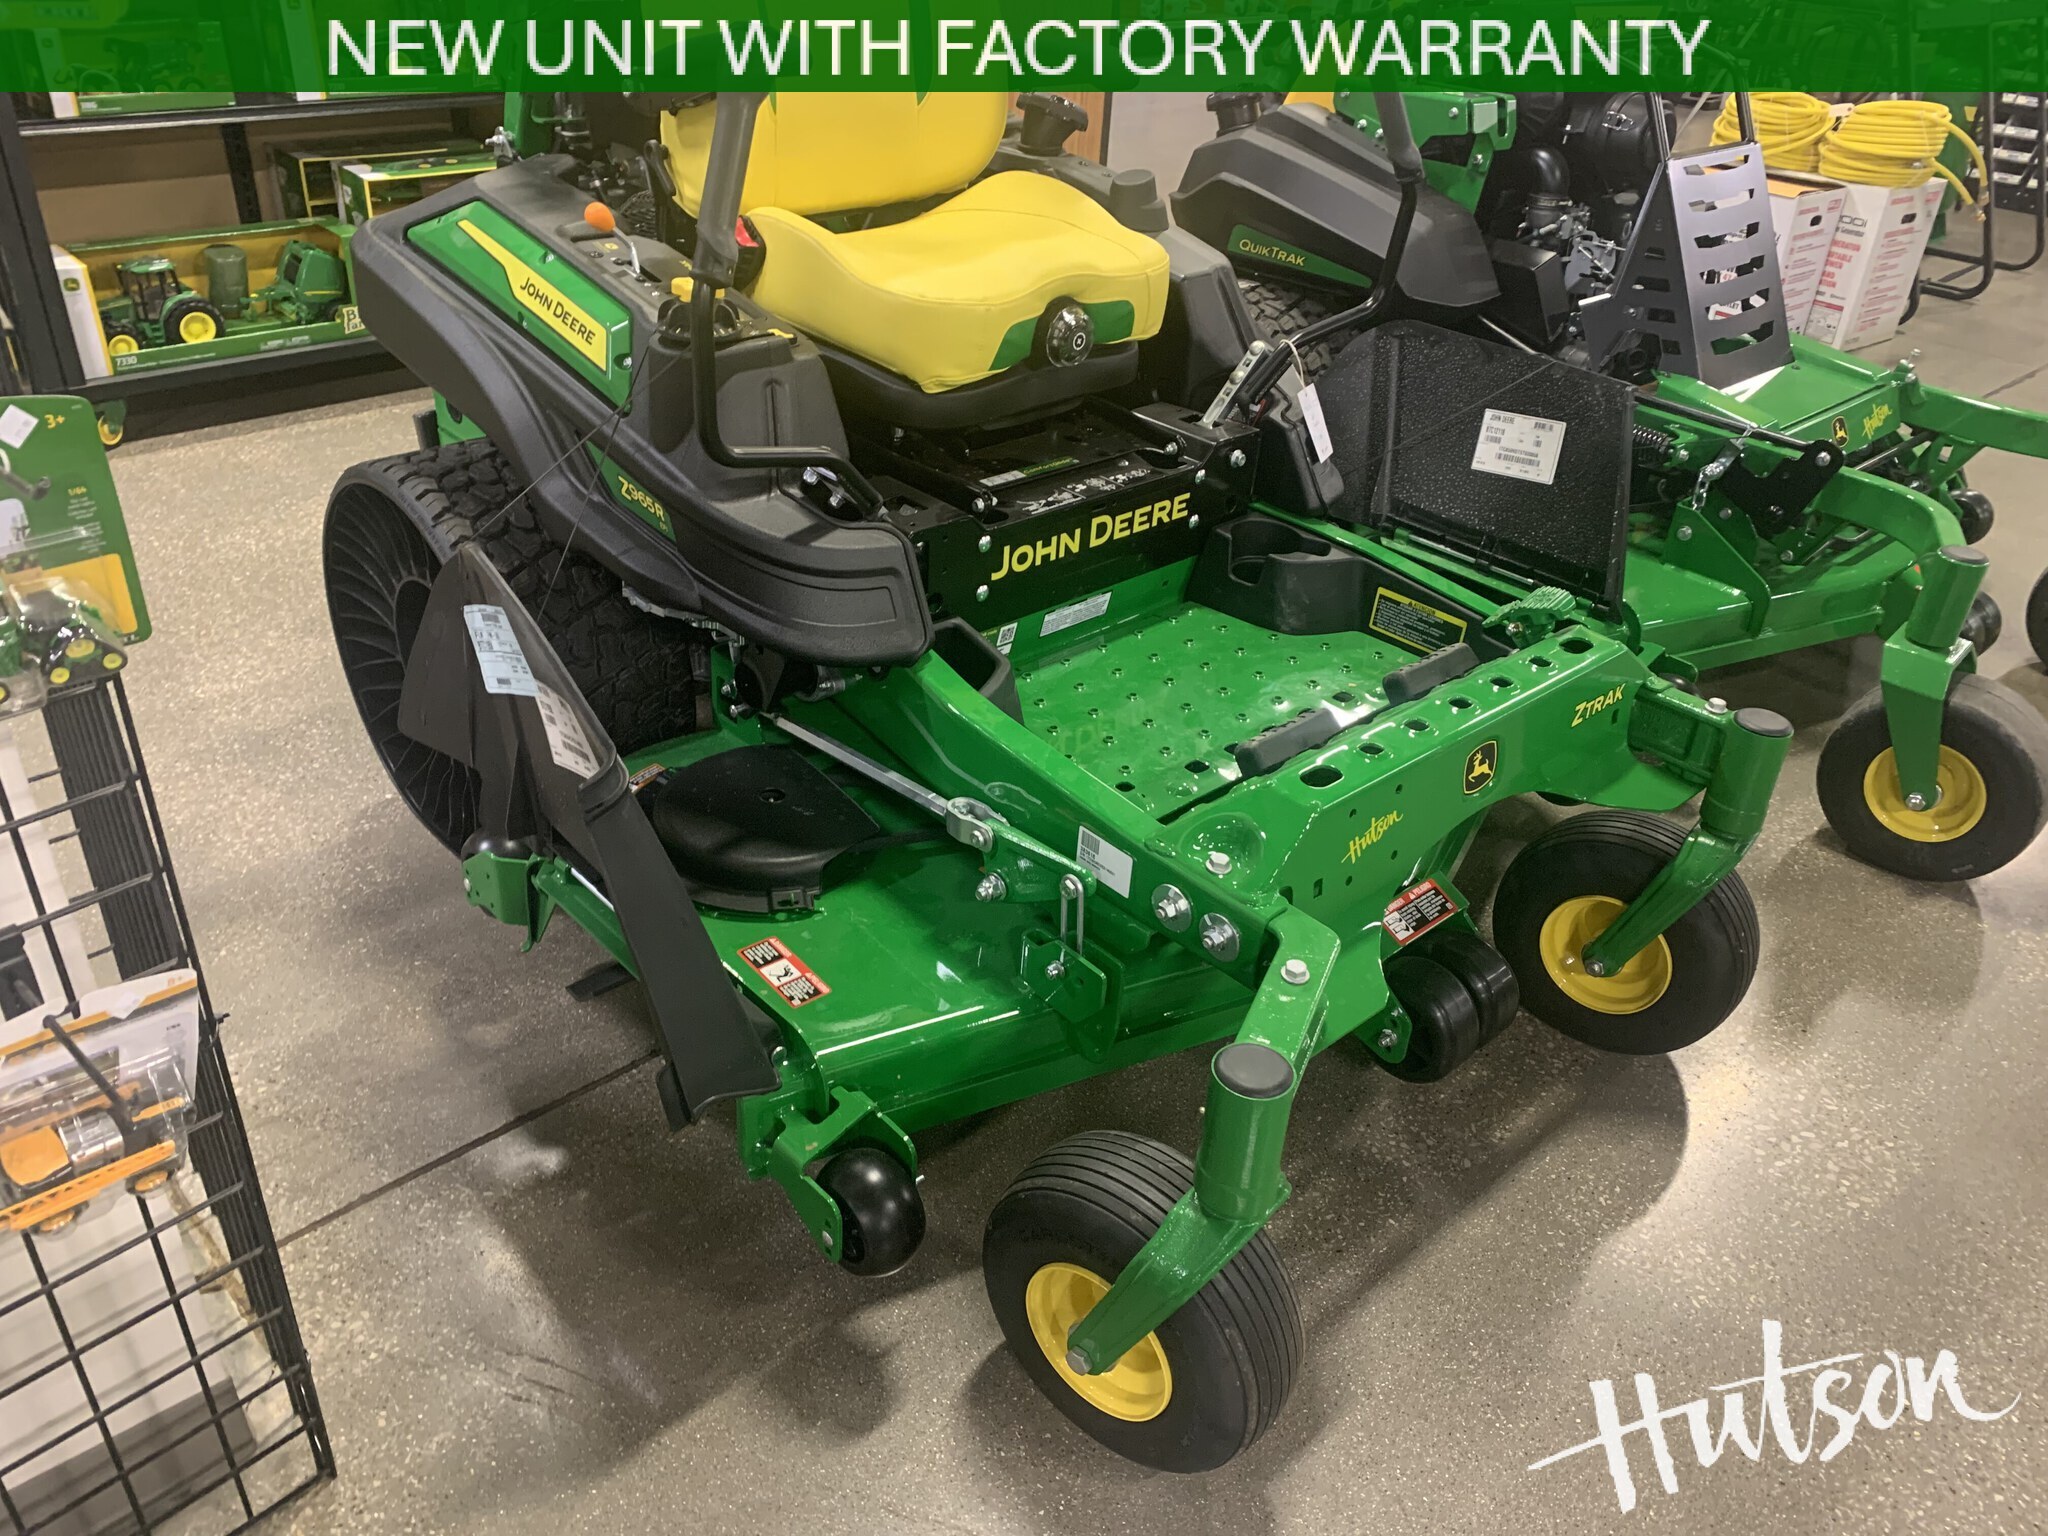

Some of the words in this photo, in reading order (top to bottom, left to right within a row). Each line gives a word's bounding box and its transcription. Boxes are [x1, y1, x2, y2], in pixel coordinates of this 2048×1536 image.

[520, 277, 553, 311] JOHN
[553, 301, 596, 346] DEERE
[115, 356, 138, 367] 7330
[44, 414, 65, 429] 3+
[618, 475, 665, 522] Z965R
[991, 528, 1082, 581] JOHN
[1089, 492, 1191, 549] DEERE
[1571, 683, 1626, 728] ZTRAK
[1341, 810, 1404, 864] Hutson
